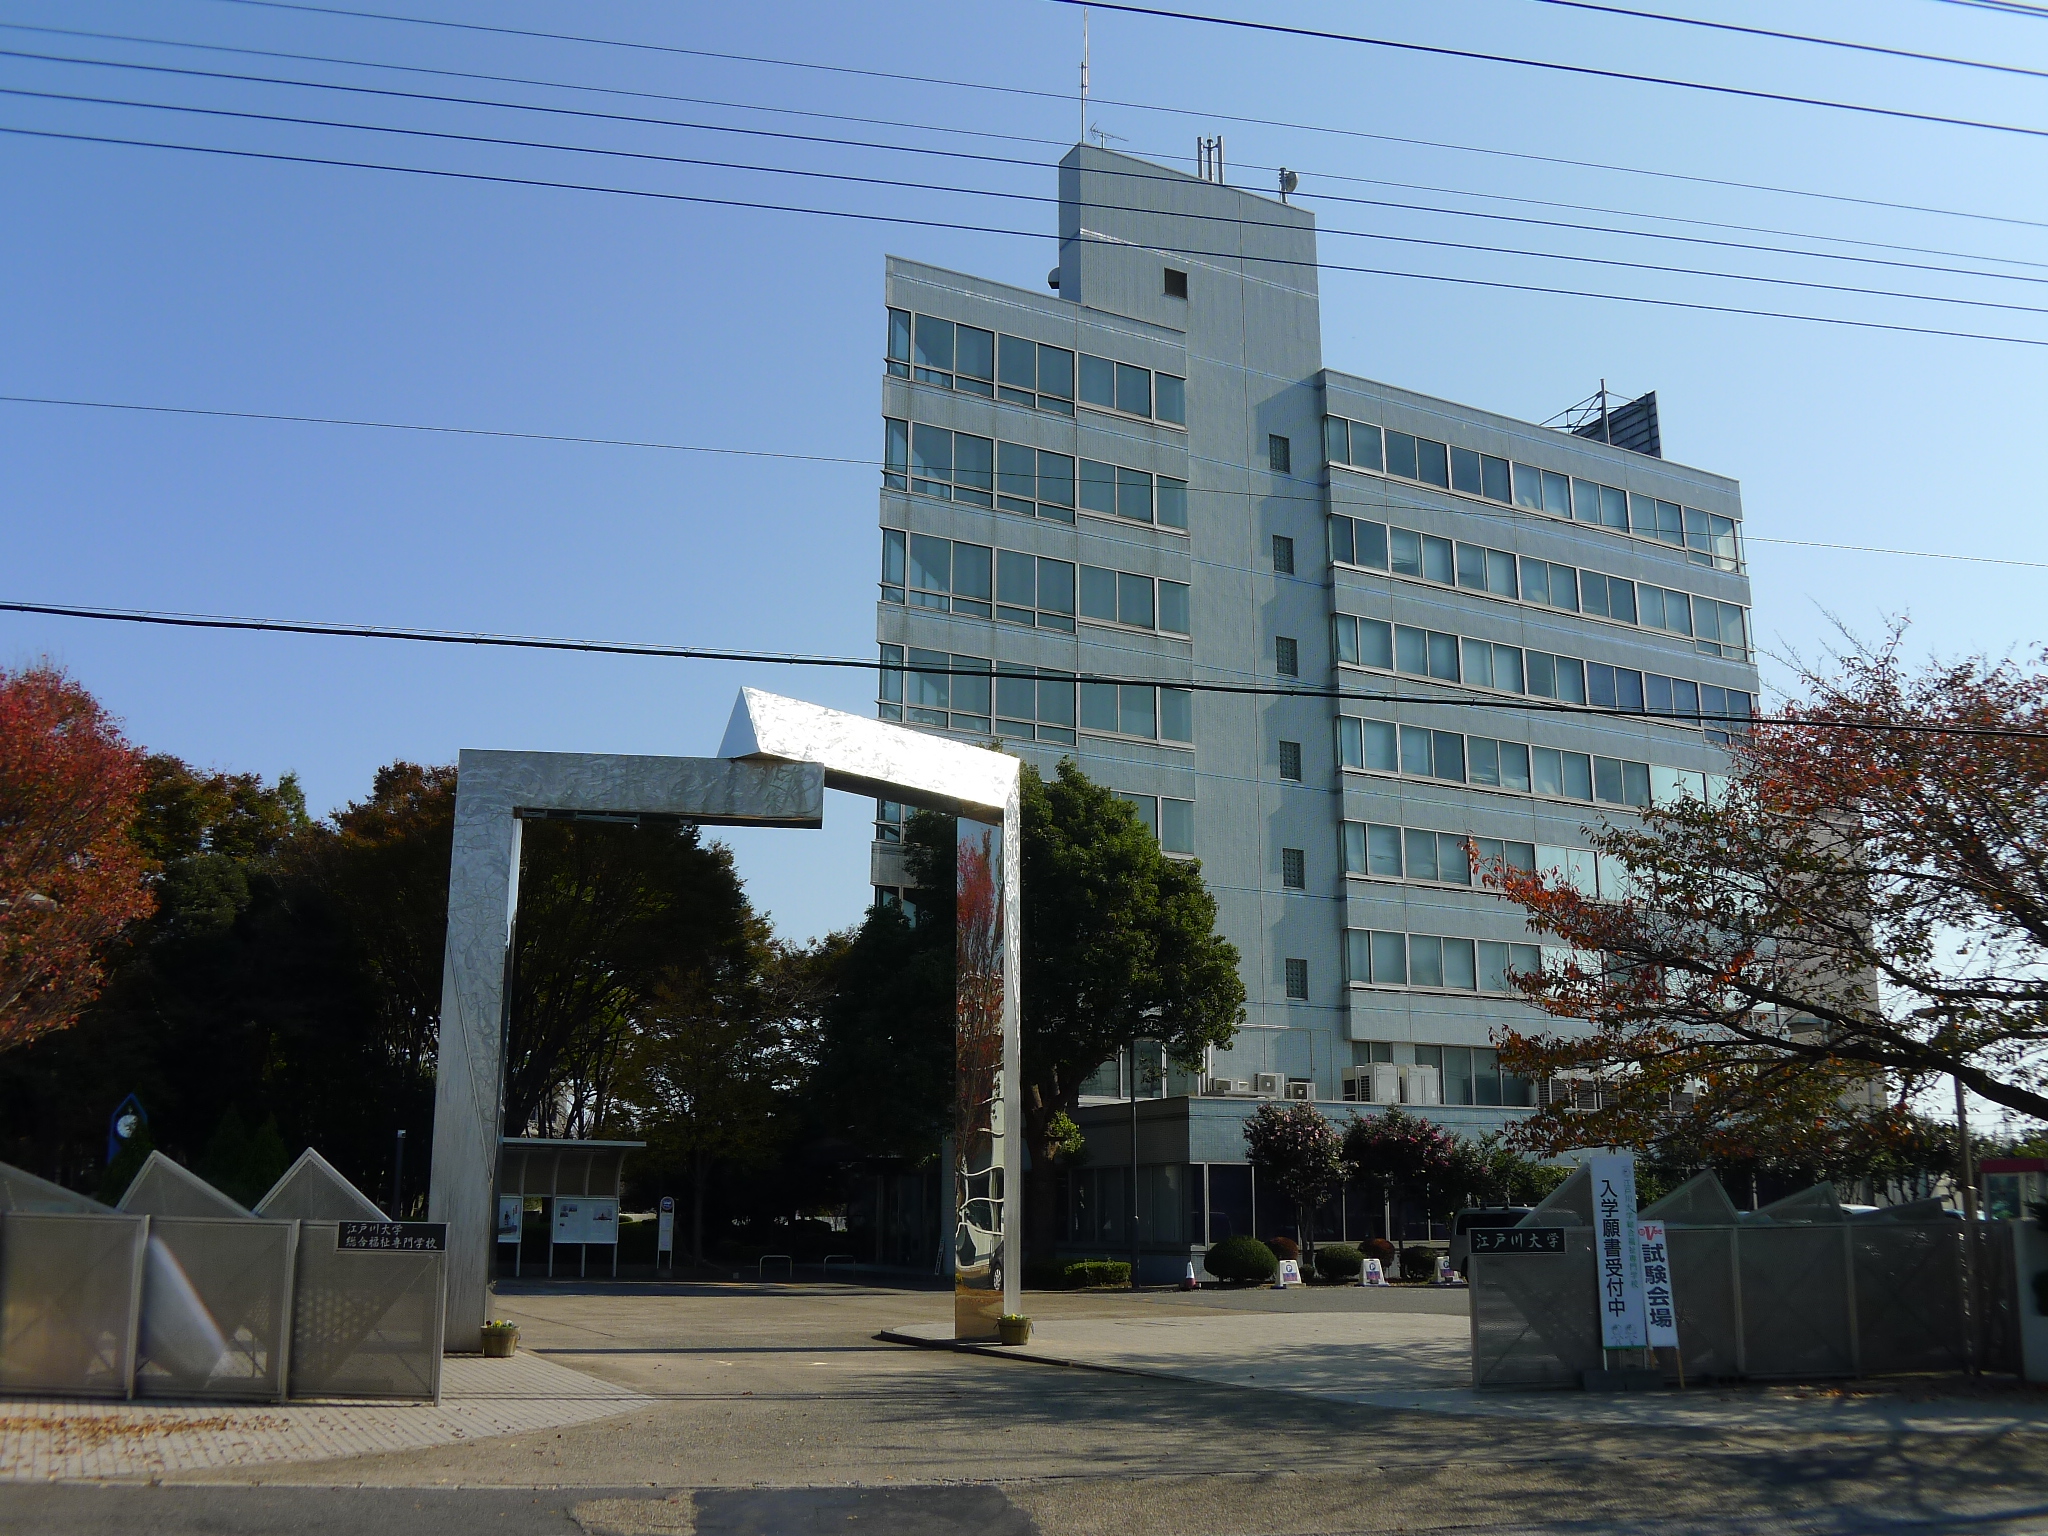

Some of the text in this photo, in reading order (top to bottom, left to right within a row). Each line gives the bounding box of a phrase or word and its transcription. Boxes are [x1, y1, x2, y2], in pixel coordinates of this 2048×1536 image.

[346, 1223, 403, 1236] 江戸川大学
[345, 1236, 438, 1249] 総合福祉専門学校
[1476, 1232, 1560, 1249] 江戸川大学
[1600, 1180, 1626, 1318] 入学願書受付中
[1641, 1243, 1672, 1328] 試験会場
